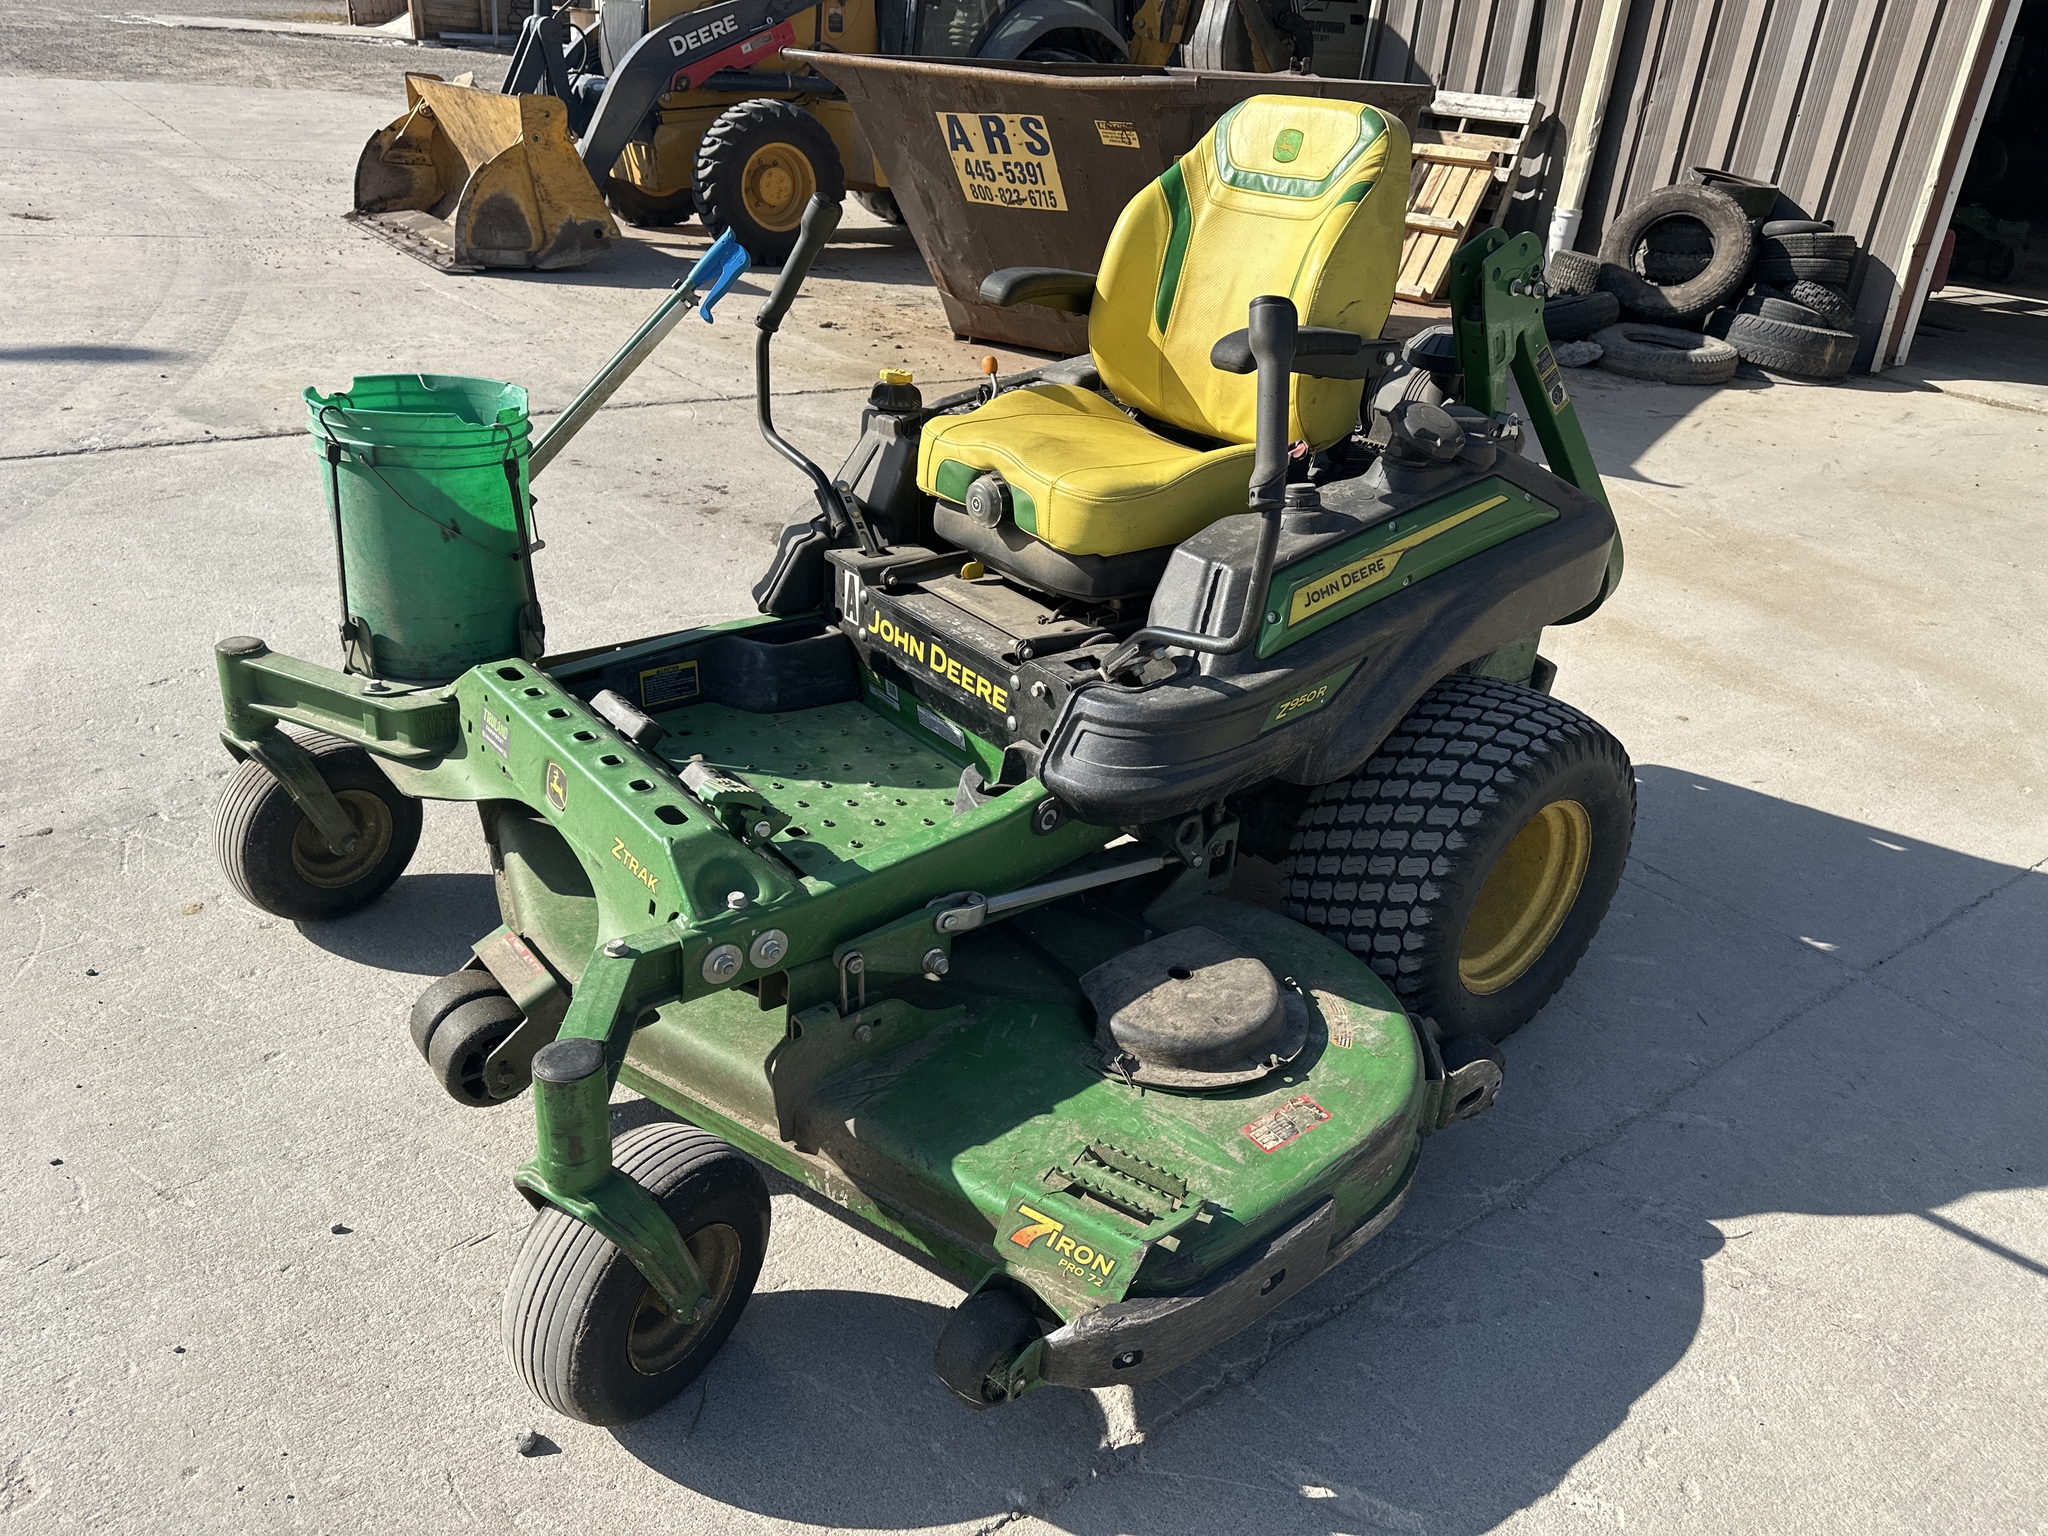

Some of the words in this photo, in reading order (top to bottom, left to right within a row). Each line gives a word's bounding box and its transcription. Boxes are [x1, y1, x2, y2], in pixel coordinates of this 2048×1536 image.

[669, 14, 739, 57] DEERE
[965, 158, 1046, 186] 445-5391
[1304, 580, 1340, 608] JOHN
[1340, 558, 1385, 589] DEERE
[868, 610, 925, 663] JOHN
[930, 642, 1008, 713] DEERE
[1275, 685, 1328, 721] Z950R
[611, 836, 659, 894] ZTRAK
[1058, 1258, 1085, 1277] PRO
[1087, 1273, 1104, 1287] 72
